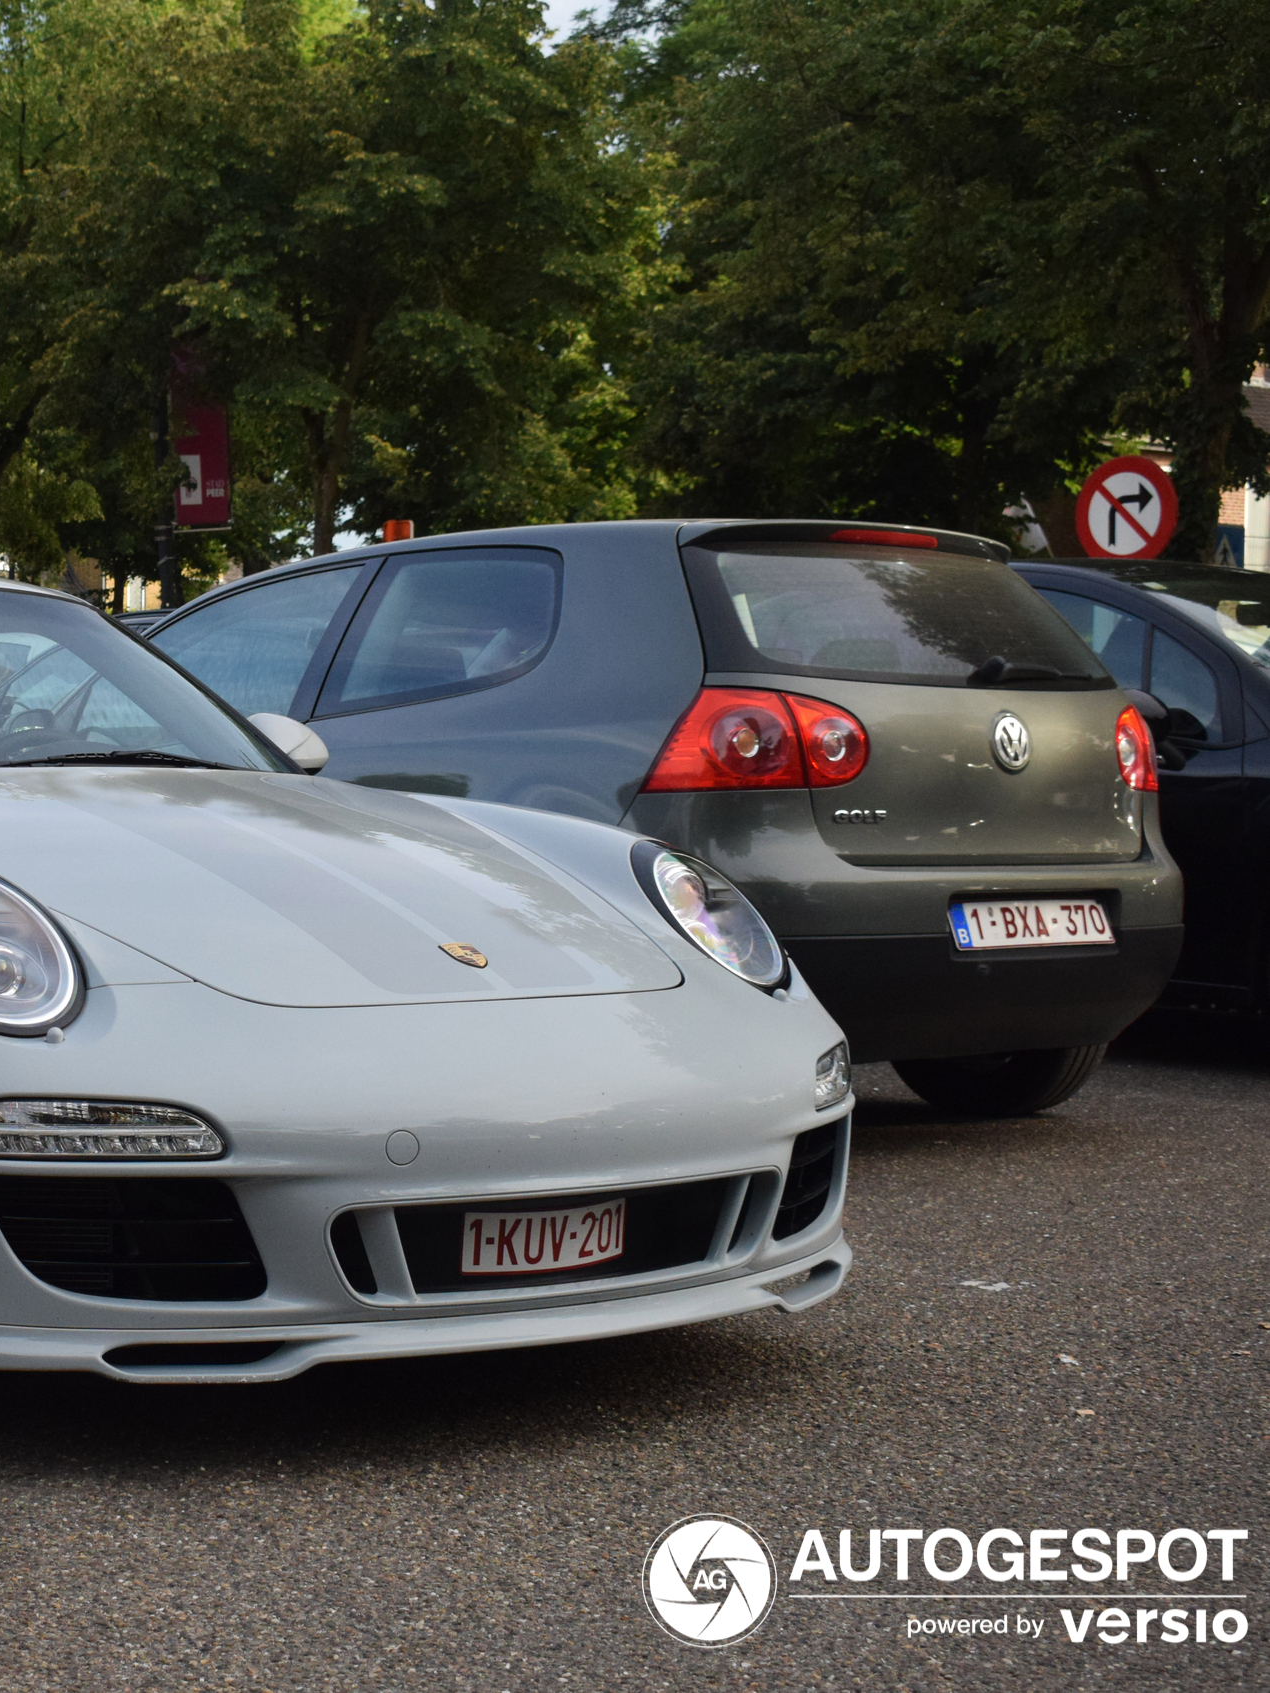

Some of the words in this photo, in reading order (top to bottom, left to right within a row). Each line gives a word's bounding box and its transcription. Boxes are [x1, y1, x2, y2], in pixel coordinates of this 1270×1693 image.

[206, 488, 225, 498] PEER
[834, 809, 887, 824] GOLF
[957, 928, 970, 944] B
[971, 904, 1106, 940] 1-BXA-370
[469, 1203, 623, 1266] 1-KUV-201
